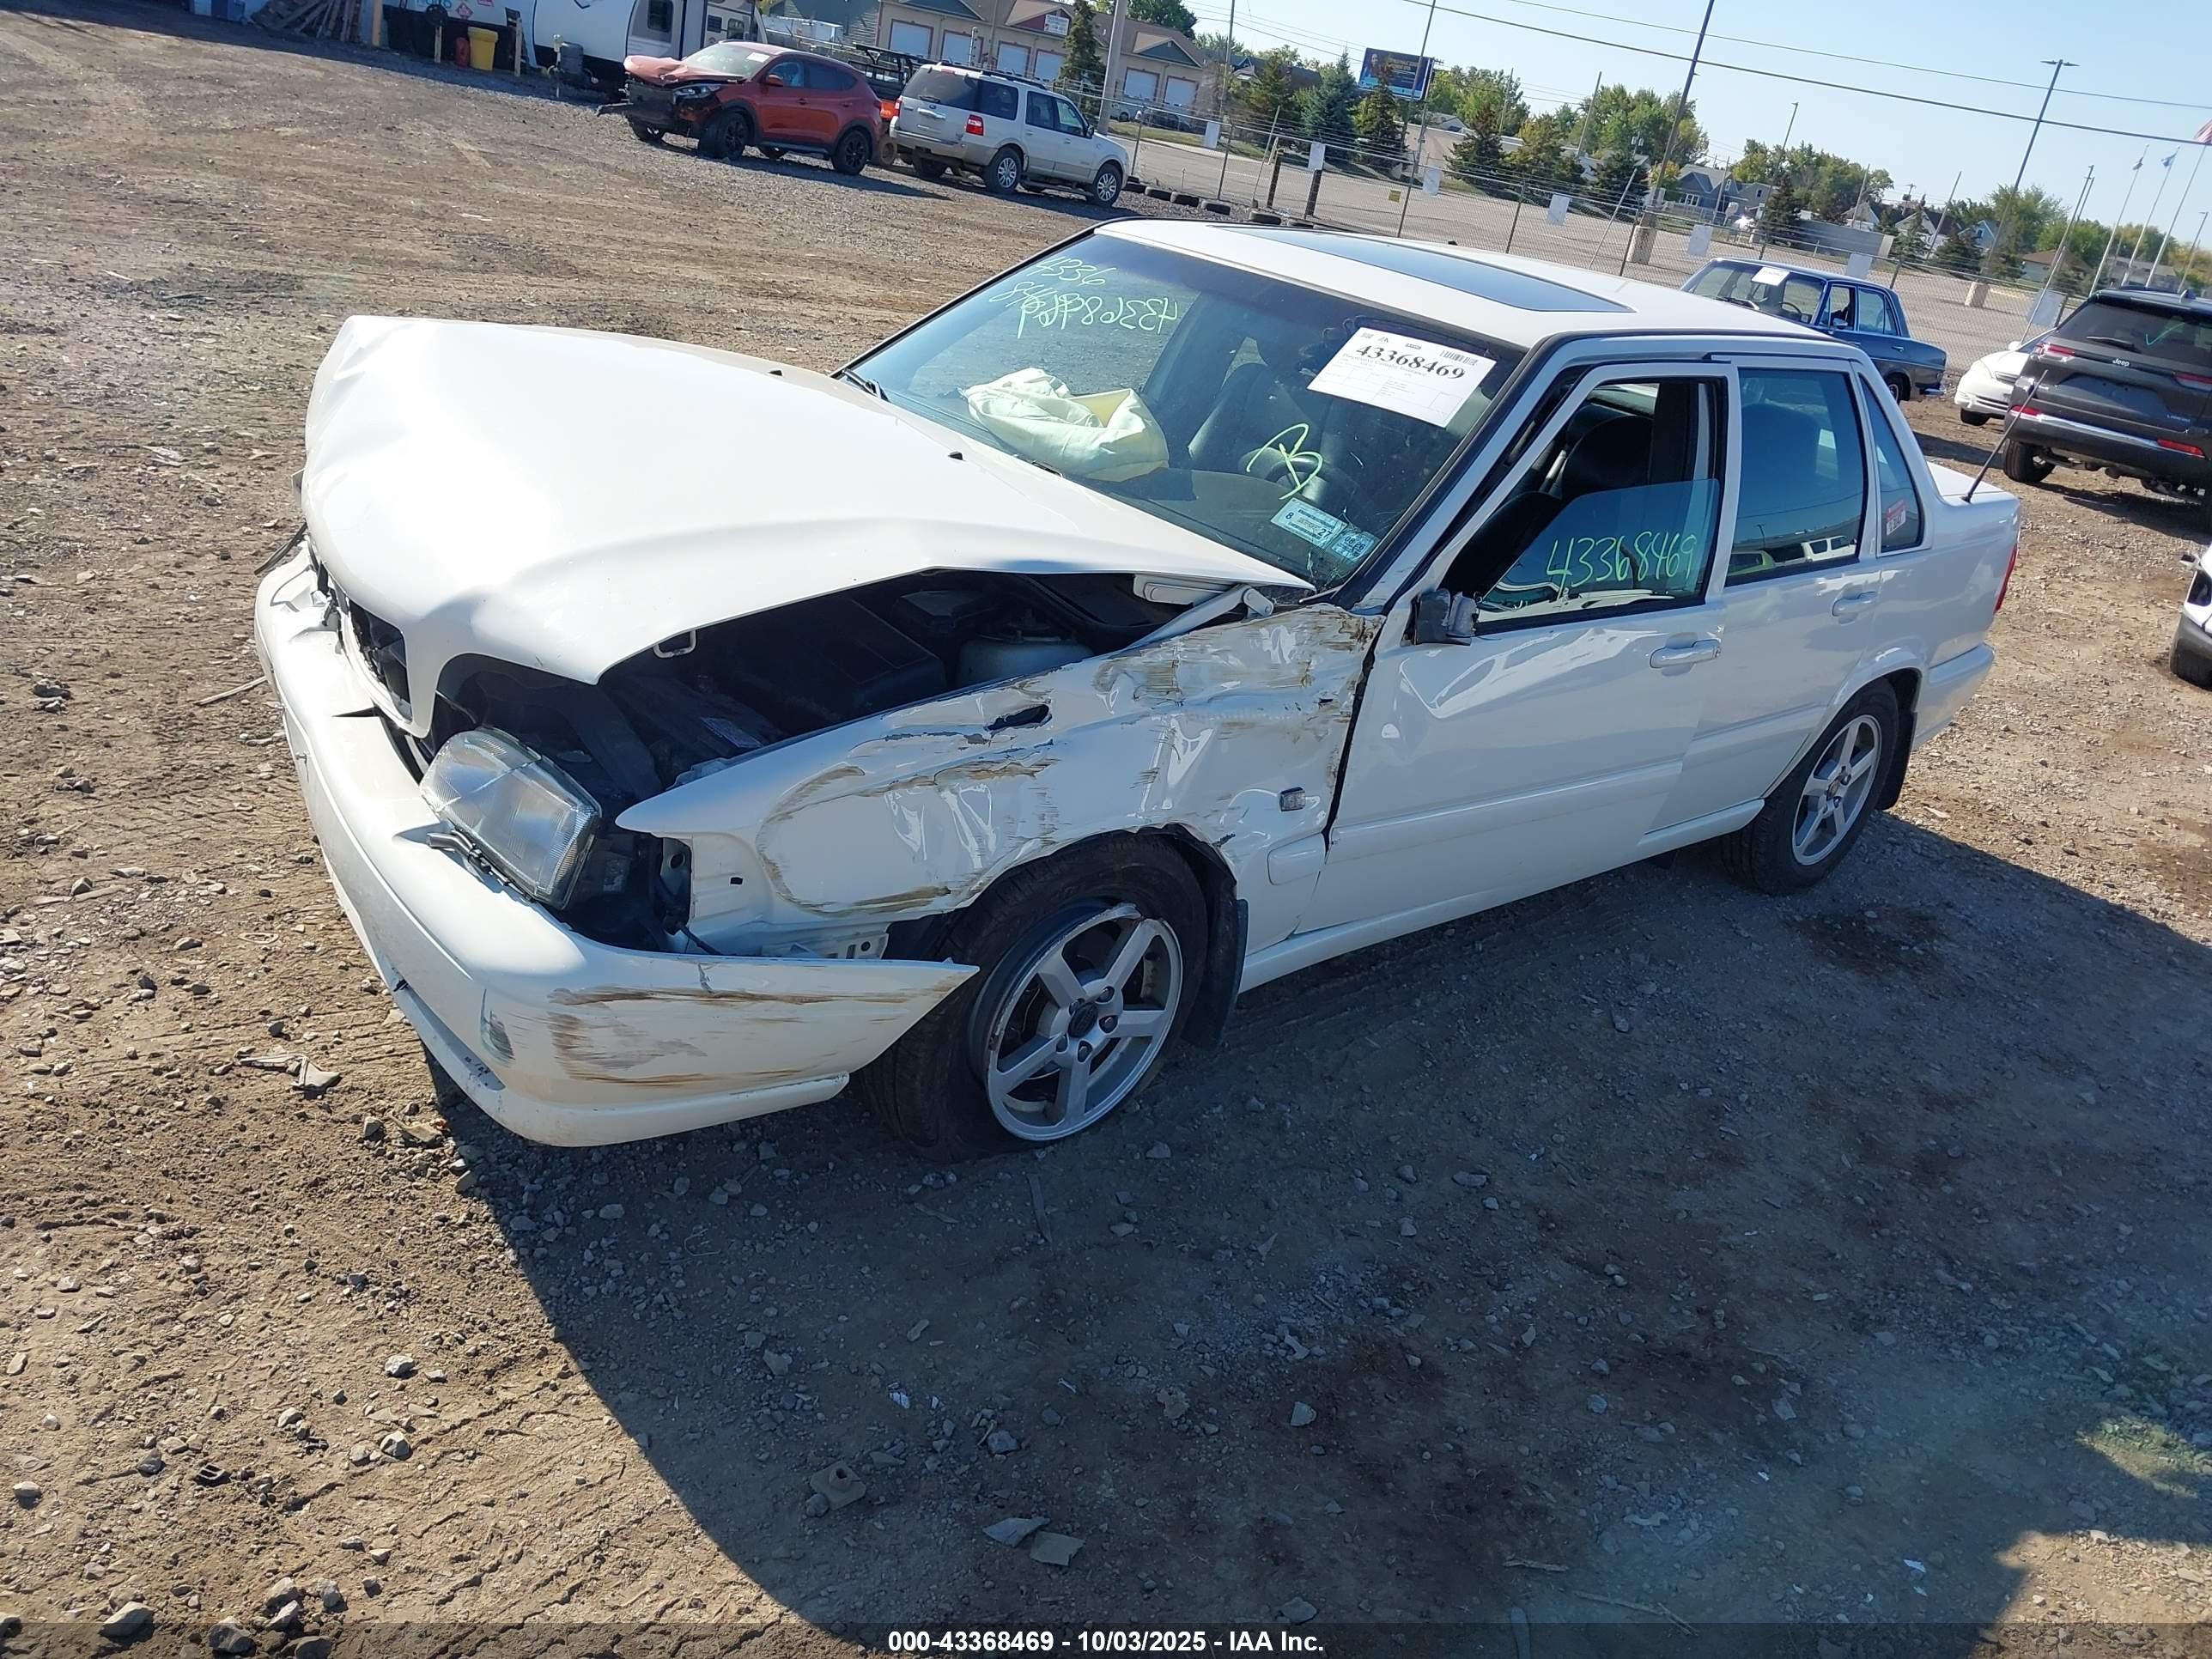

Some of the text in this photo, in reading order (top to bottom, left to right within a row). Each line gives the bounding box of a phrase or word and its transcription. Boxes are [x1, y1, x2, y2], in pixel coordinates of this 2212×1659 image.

[1026, 256, 1117, 287] 4336
[1356, 344, 1466, 379] 43368469
[2112, 358, 2130, 367] Jeep
[1317, 528, 1333, 538] 27
[1546, 531, 1697, 602] 43368469
